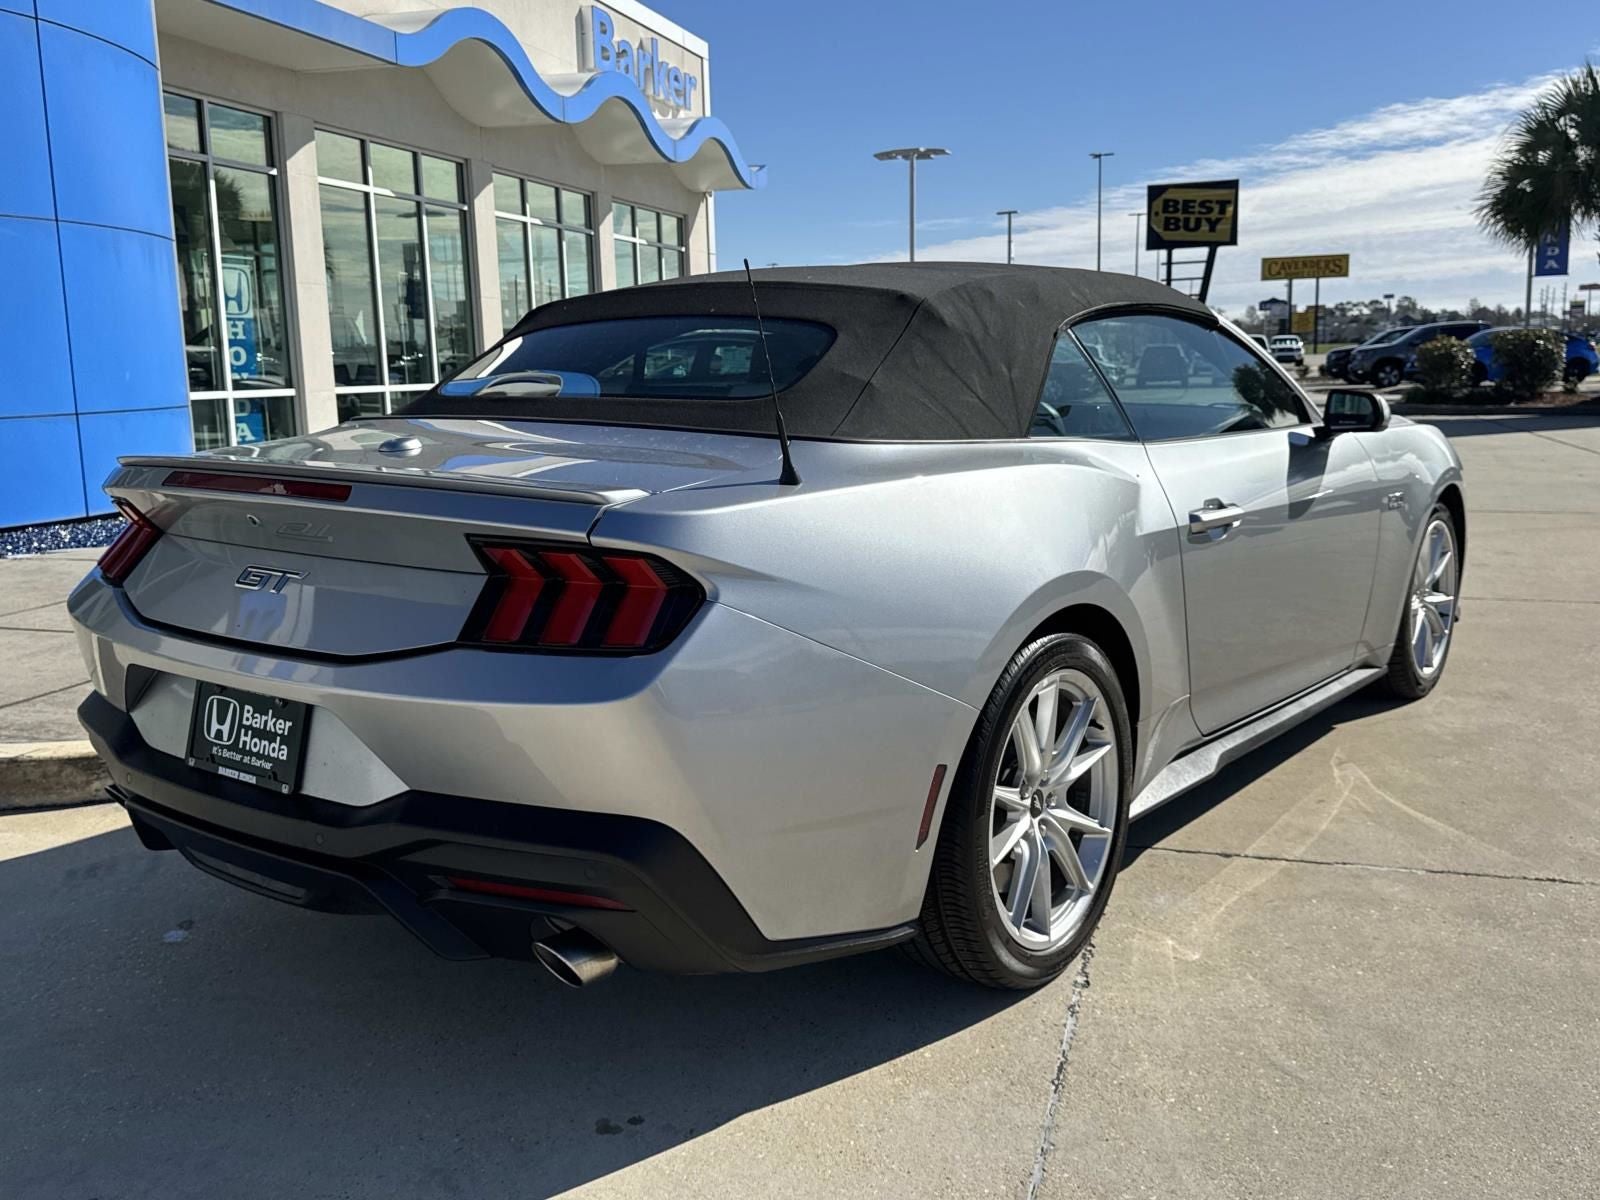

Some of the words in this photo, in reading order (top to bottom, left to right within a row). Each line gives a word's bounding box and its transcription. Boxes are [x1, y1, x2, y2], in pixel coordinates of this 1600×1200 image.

[591, 5, 697, 111] Barker
[1162, 198, 1232, 216] BEST
[1162, 216, 1225, 233] BUY
[226, 320, 256, 442] HODA
[234, 564, 311, 595] GT
[242, 704, 293, 736] Barker
[222, 749, 242, 761] Better
[243, 755, 250, 764] at
[250, 756, 273, 770] Barker
[238, 728, 288, 761] Honda
